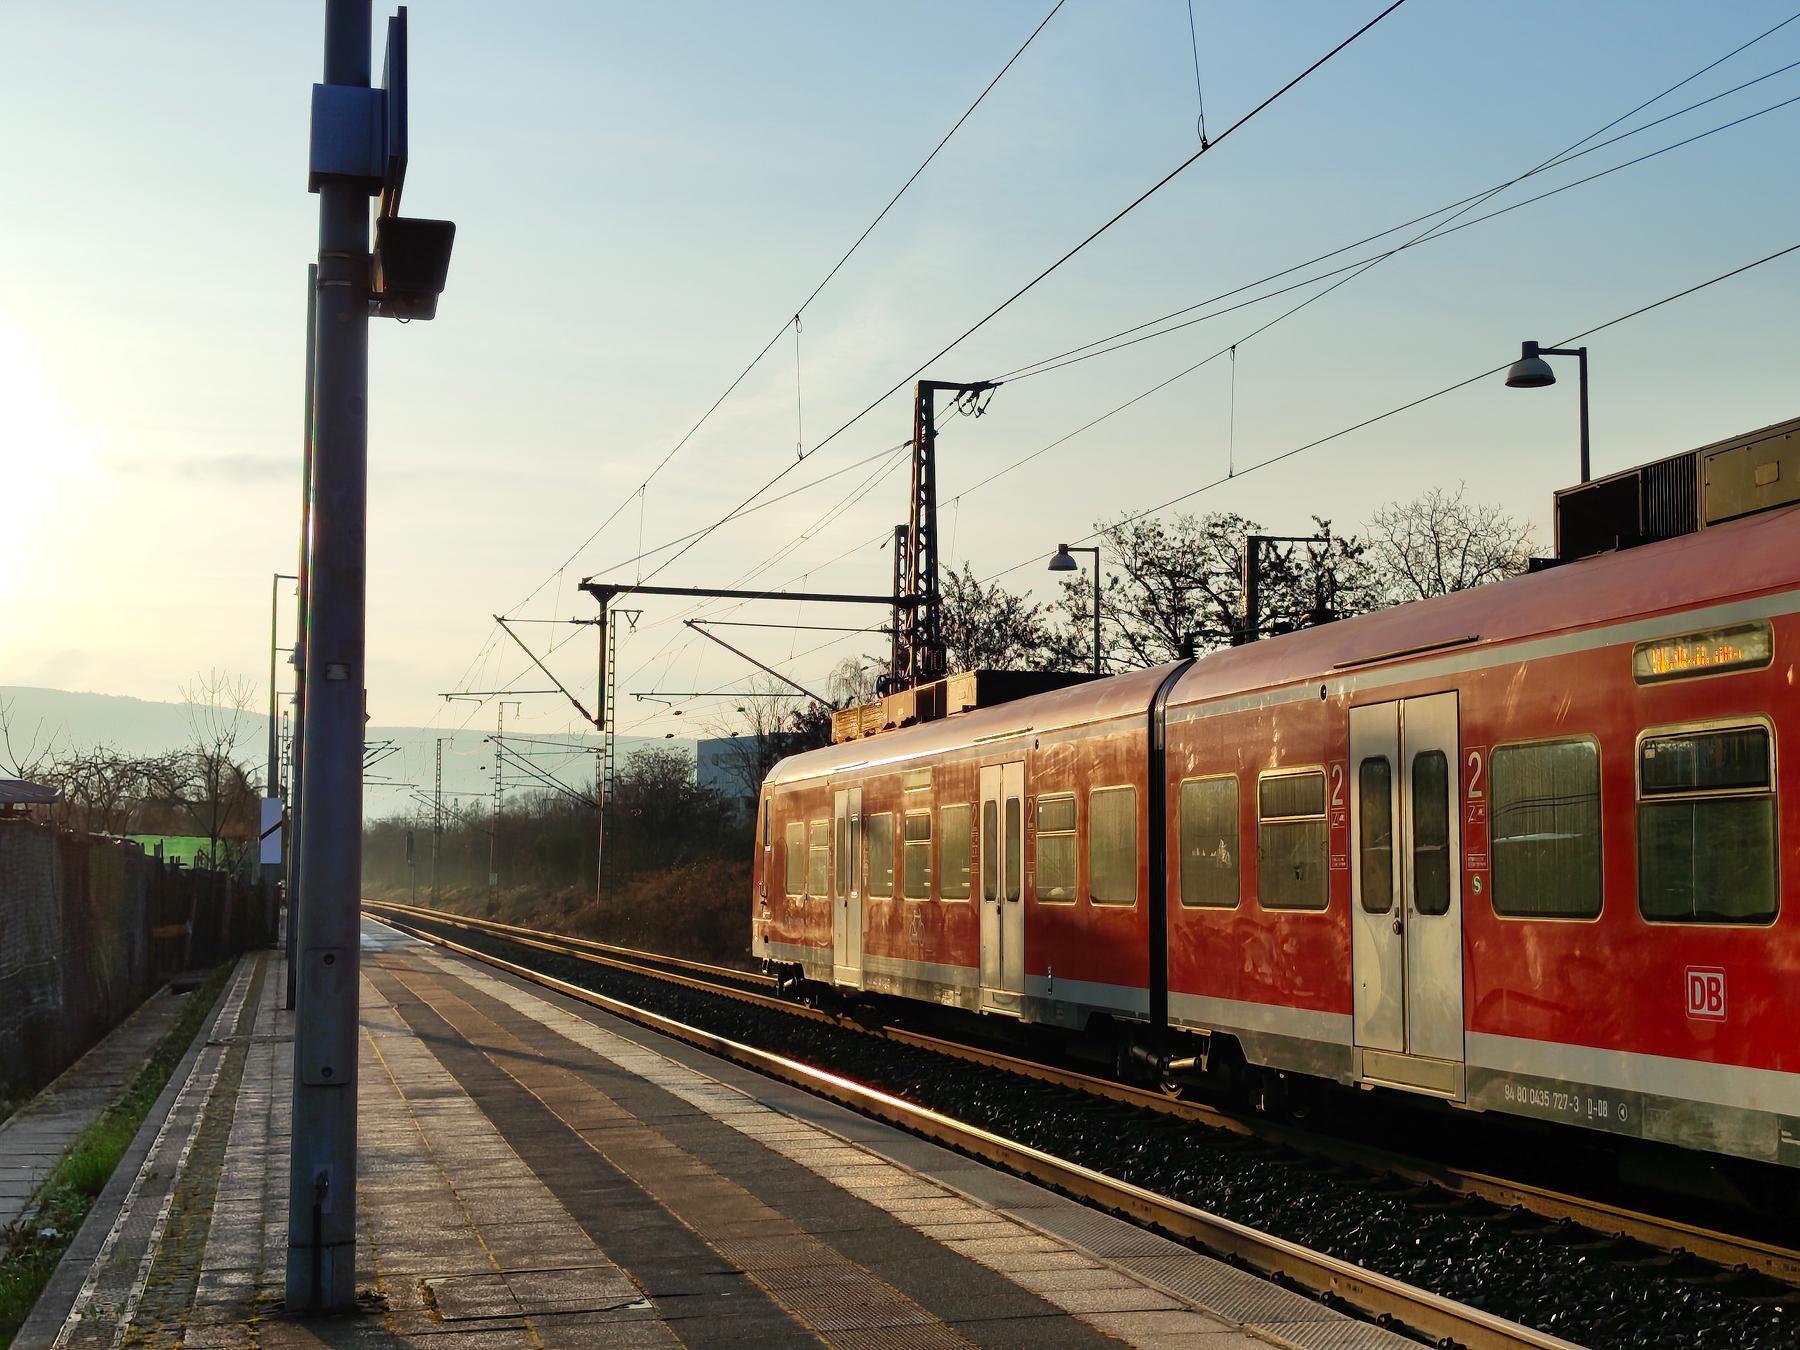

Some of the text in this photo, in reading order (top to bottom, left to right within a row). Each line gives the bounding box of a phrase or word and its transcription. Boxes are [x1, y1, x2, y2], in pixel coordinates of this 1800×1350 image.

[1332, 764, 1343, 806] 2
[1468, 751, 1482, 798] 2
[1690, 974, 1723, 1012] DB
[1505, 1085, 1514, 1100] 94
[1517, 1086, 1527, 1103] 80
[1529, 1088, 1549, 1107] 0435
[1553, 1092, 1579, 1112] 727-3
